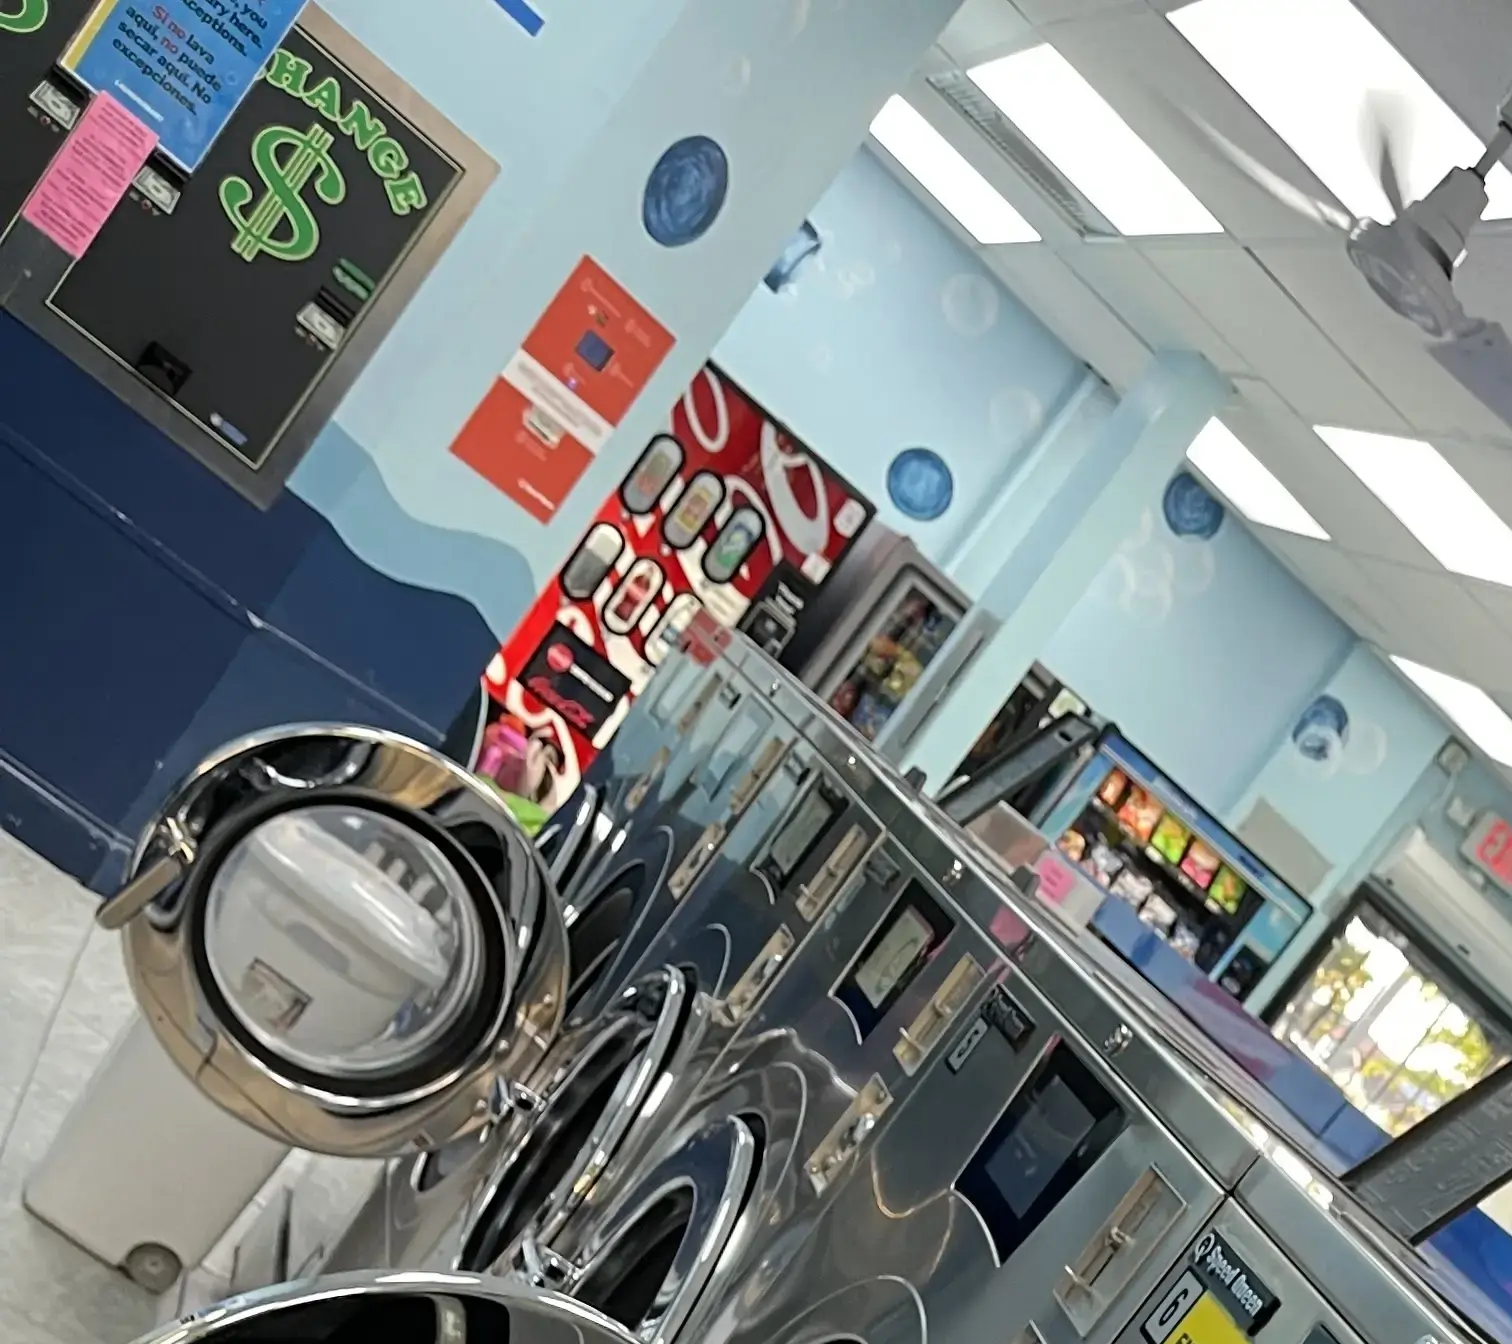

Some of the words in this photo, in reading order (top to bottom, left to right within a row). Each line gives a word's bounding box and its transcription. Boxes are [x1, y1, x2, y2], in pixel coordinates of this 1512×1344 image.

[118, 20, 158, 57] secar
[186, 34, 215, 65] lava
[178, 52, 222, 92] puede
[256, 48, 428, 216] HANGE
[1206, 1245, 1241, 1286] Speed
[1230, 1273, 1264, 1318] Queen
[1158, 1287, 1190, 1327] 6
